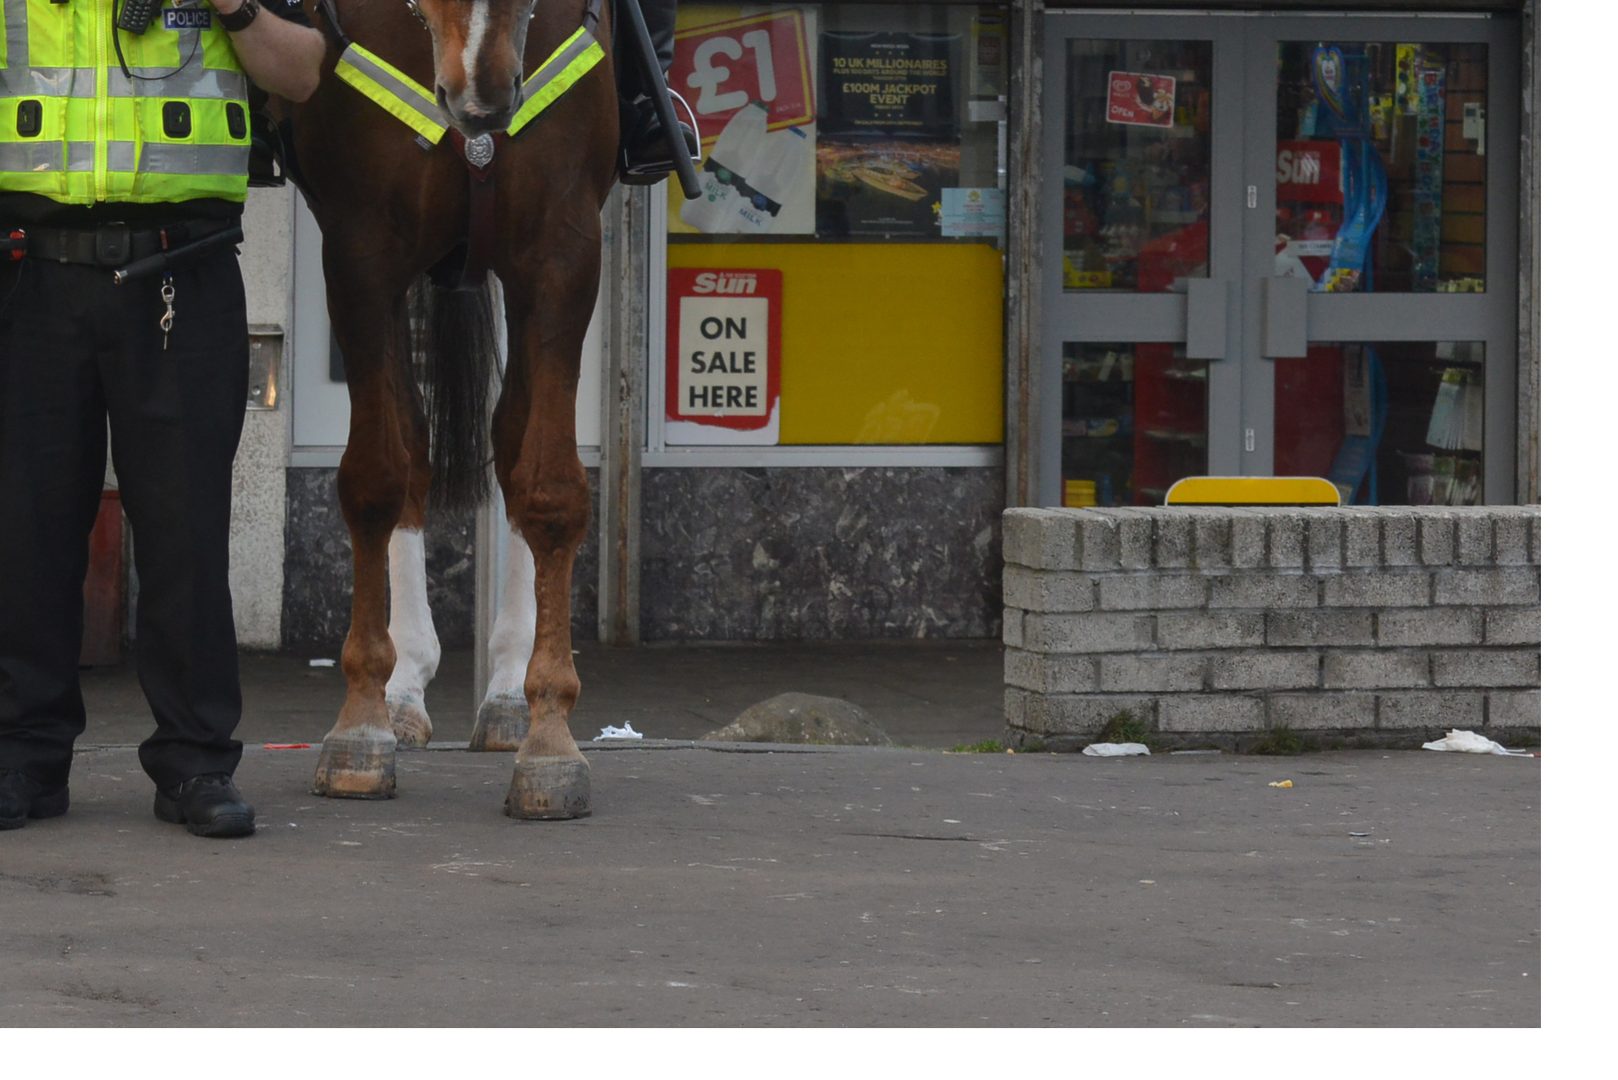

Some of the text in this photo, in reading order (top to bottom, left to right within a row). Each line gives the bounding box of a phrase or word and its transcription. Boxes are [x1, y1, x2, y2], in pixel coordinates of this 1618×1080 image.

[167, 11, 209, 26] POLICE
[686, 29, 777, 115] £1
[833, 57, 948, 70] 10 UK MILLIONAIRES
[843, 83, 937, 95] £100M JACKPOT
[870, 94, 910, 104] EVENT
[1111, 105, 1135, 117] OPEN
[1278, 149, 1320, 184] Sun
[705, 182, 728, 200] MILK
[739, 207, 762, 226] MILK
[692, 272, 757, 293] Sun
[700, 316, 747, 340] ON
[691, 351, 756, 374] SALE
[689, 386, 757, 408] HERE
